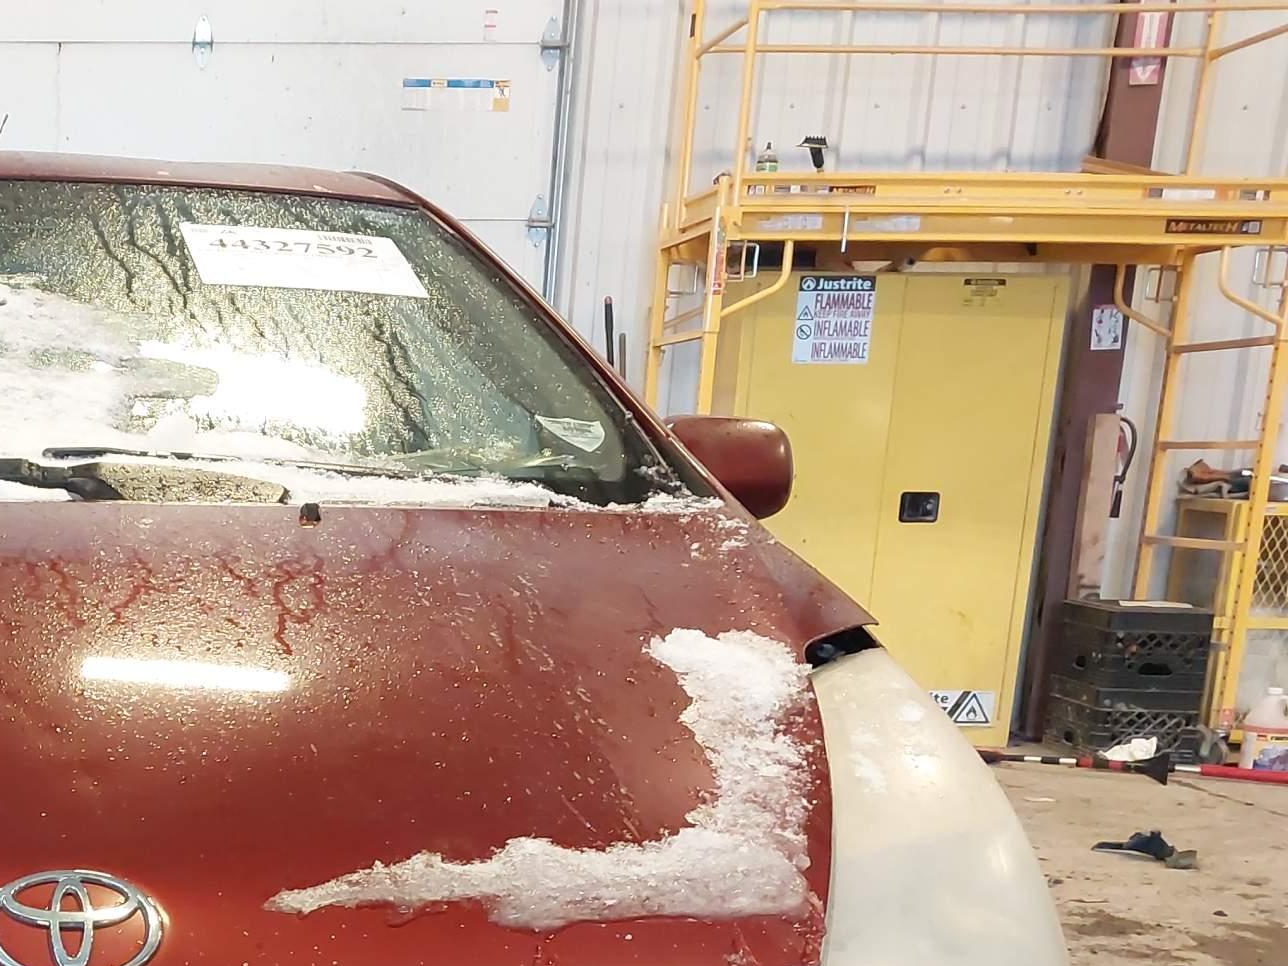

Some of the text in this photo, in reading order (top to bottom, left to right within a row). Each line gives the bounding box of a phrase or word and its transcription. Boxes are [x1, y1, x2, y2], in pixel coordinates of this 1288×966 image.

[209, 238, 378, 259] 44327592
[817, 277, 872, 290] Justrite
[815, 293, 873, 309] FLAMMABLE
[813, 320, 870, 337] INFLAMABLE
[811, 342, 868, 359] INFLAMMABLE
